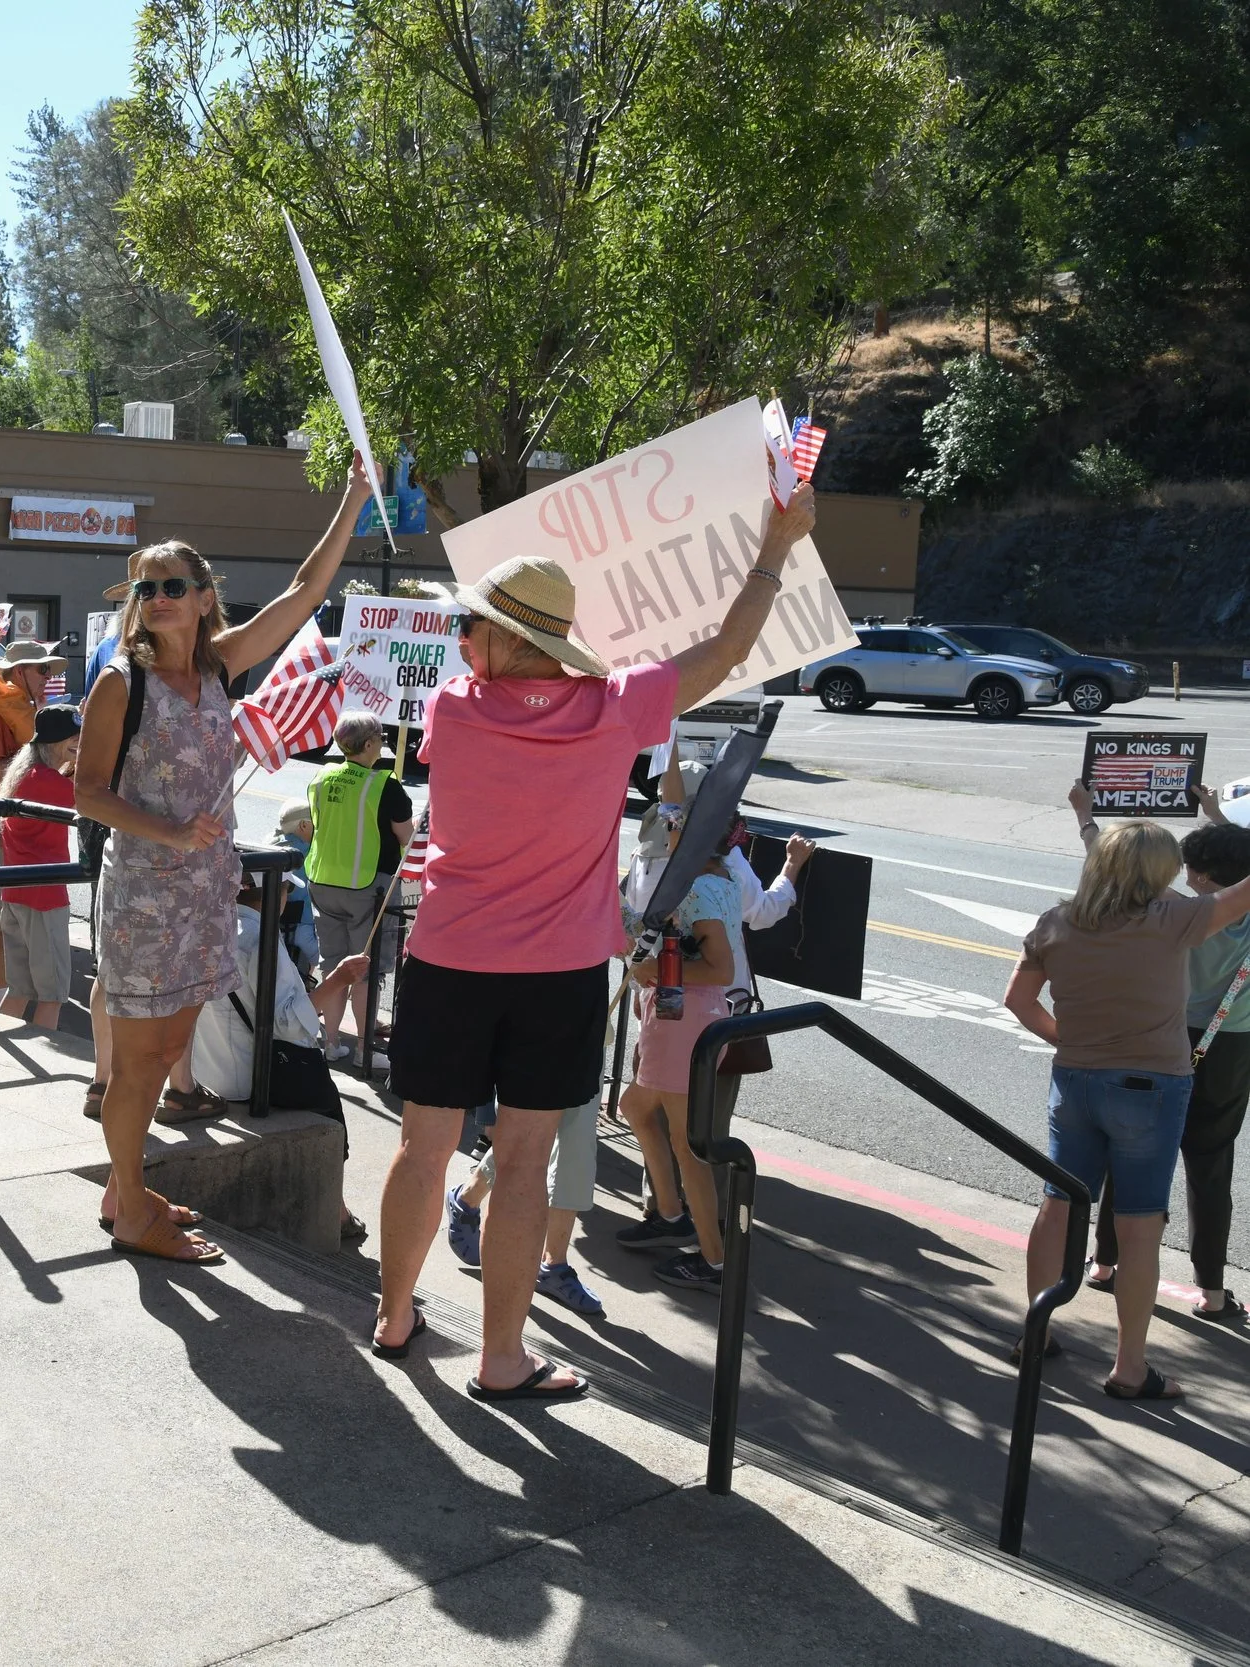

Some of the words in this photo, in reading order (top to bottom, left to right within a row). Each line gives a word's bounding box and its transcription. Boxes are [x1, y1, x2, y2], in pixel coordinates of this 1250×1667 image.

[360, 607, 398, 630] STOP
[389, 641, 446, 666] POWER
[397, 665, 438, 688] GRAB
[341, 661, 393, 716] SUPPORT
[1095, 743, 1118, 755] NO
[1126, 743, 1171, 755] KINGS
[1180, 743, 1195, 755] IN
[1154, 769, 1186, 777] DUMP
[1154, 777, 1185, 786] TRUMP
[1092, 791, 1189, 807] AMERICA
